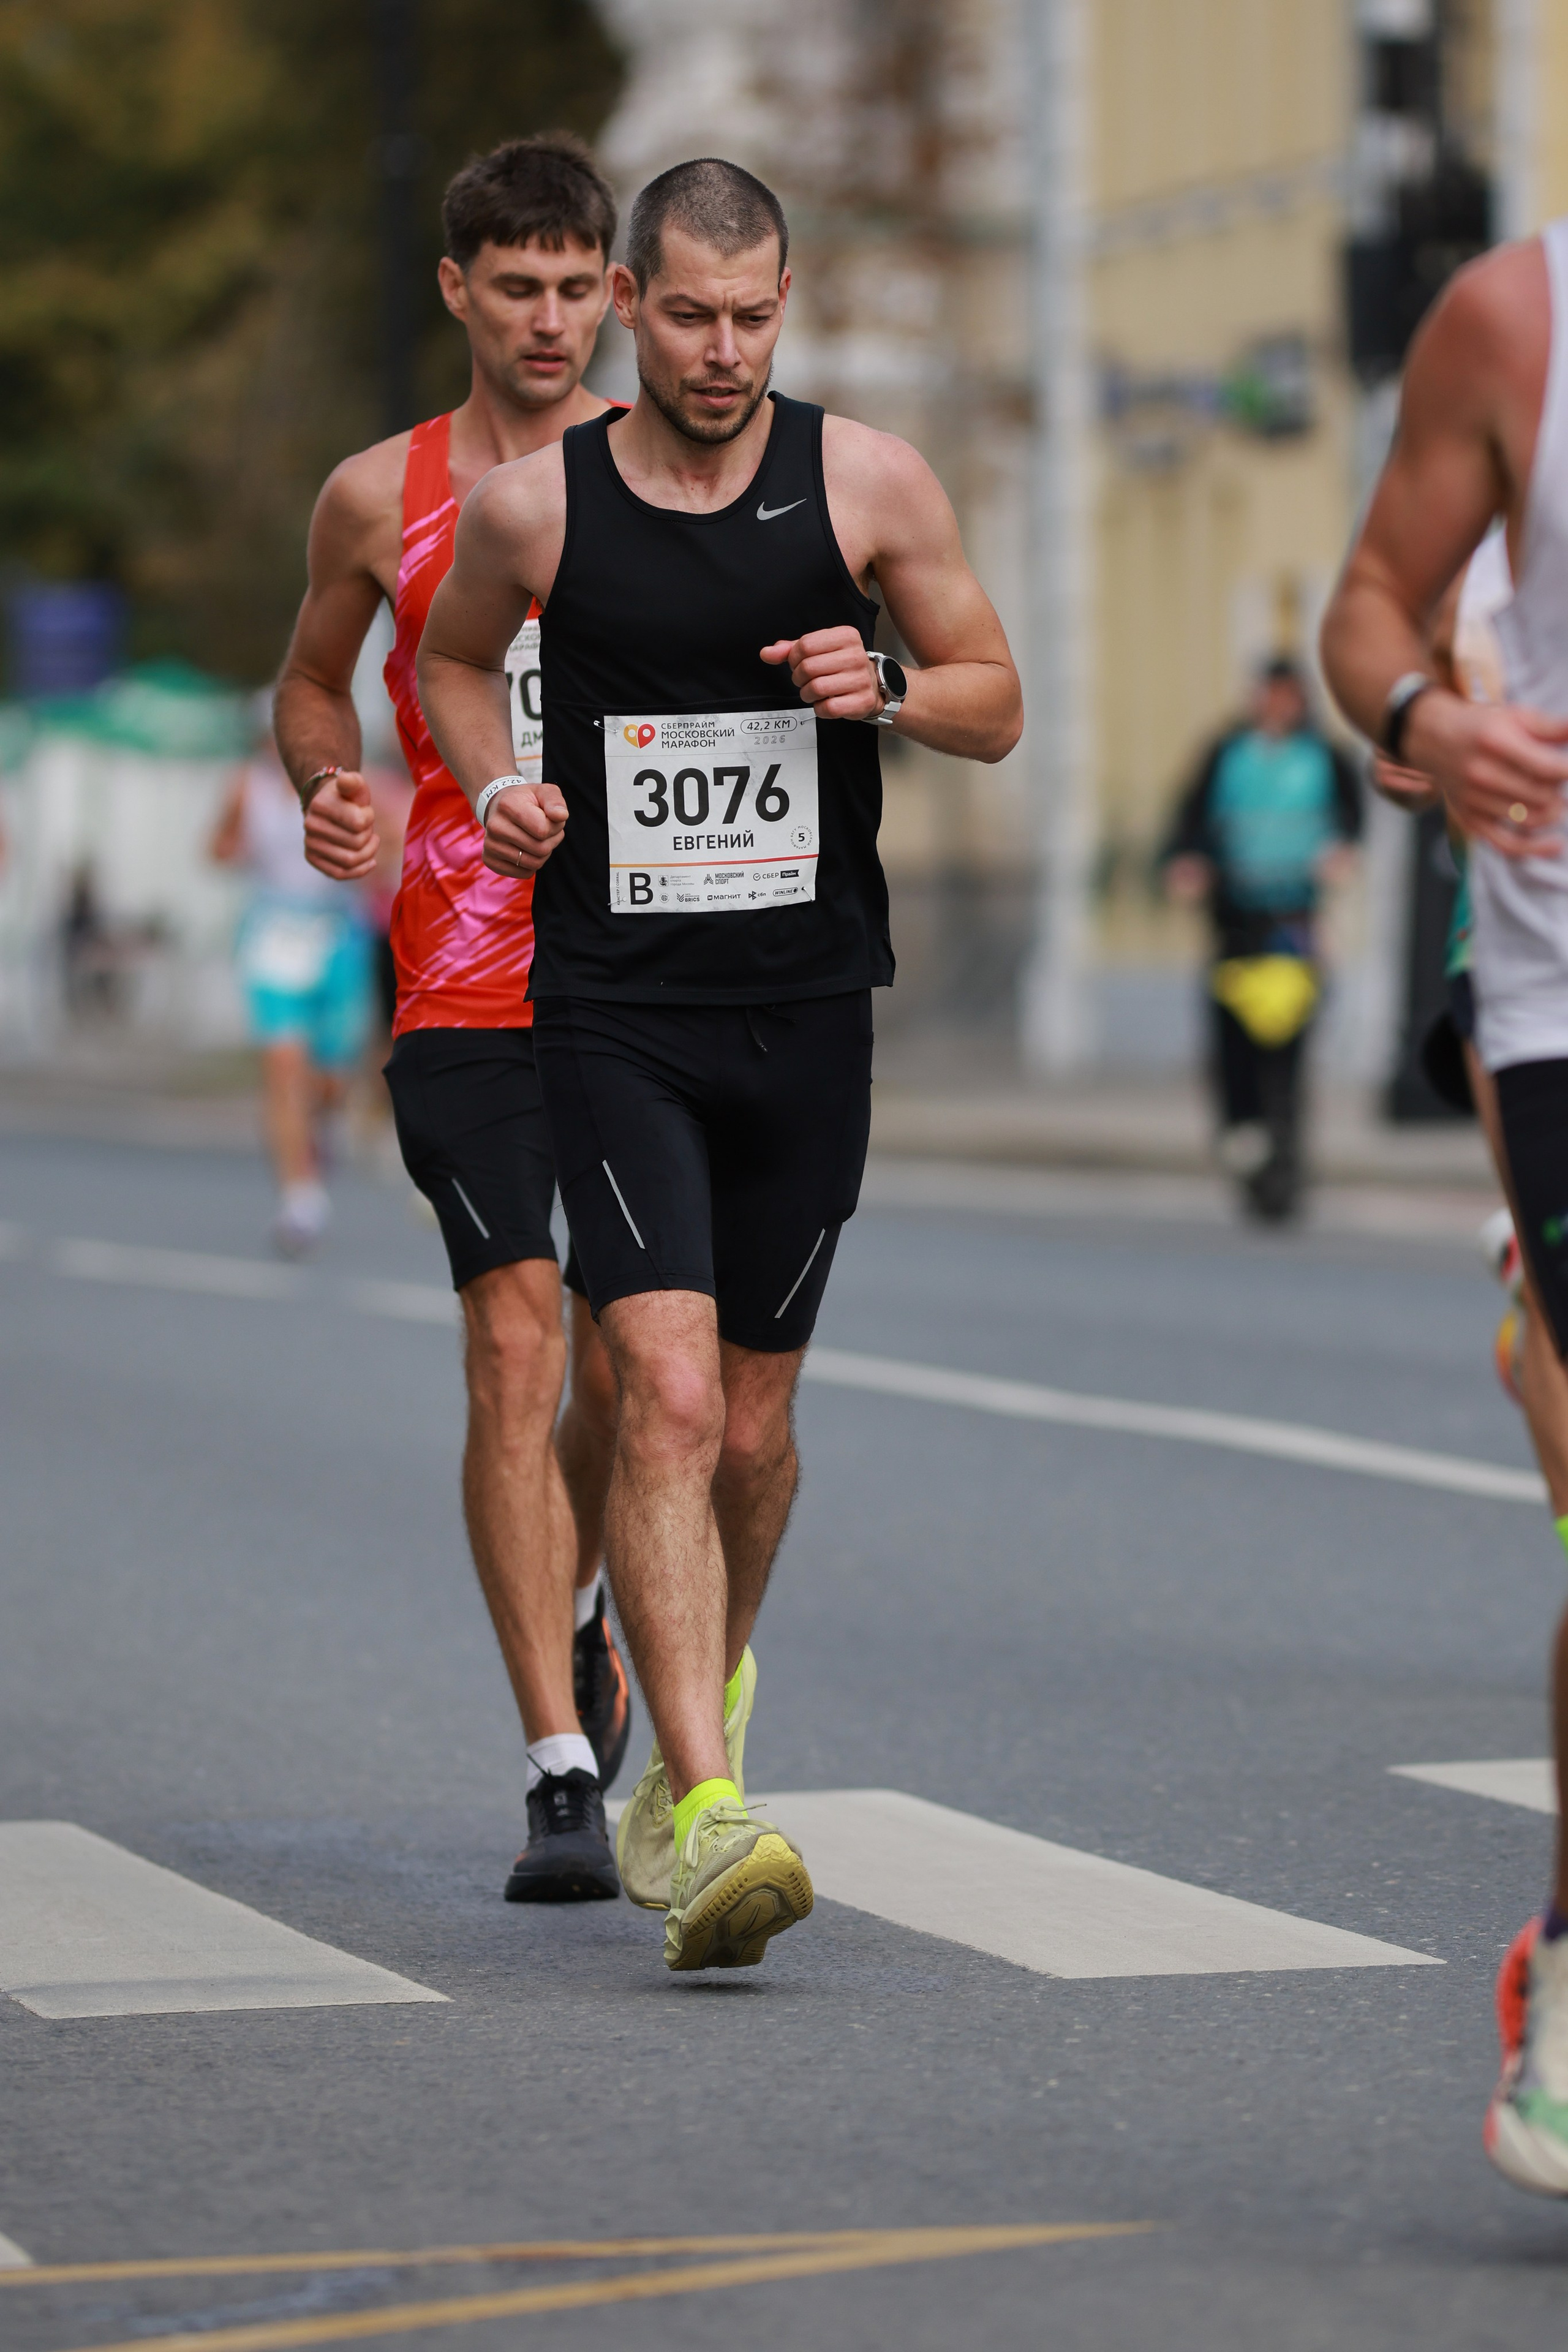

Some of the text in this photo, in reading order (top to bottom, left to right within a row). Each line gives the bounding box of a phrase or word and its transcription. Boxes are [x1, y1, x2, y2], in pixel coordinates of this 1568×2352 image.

[661, 721, 715, 729] СБЕРПРАЙМ
[747, 720, 791, 731] 42,2 КМ
[661, 727, 735, 739] МОСКОВСКИЙ
[662, 739, 716, 748] МАРАФОН
[754, 735, 786, 745] 2026
[633, 763, 790, 827] 3076
[673, 830, 754, 851] ЕВГЕНИЙ
[798, 832, 805, 842] 5
[629, 872, 654, 905] B
